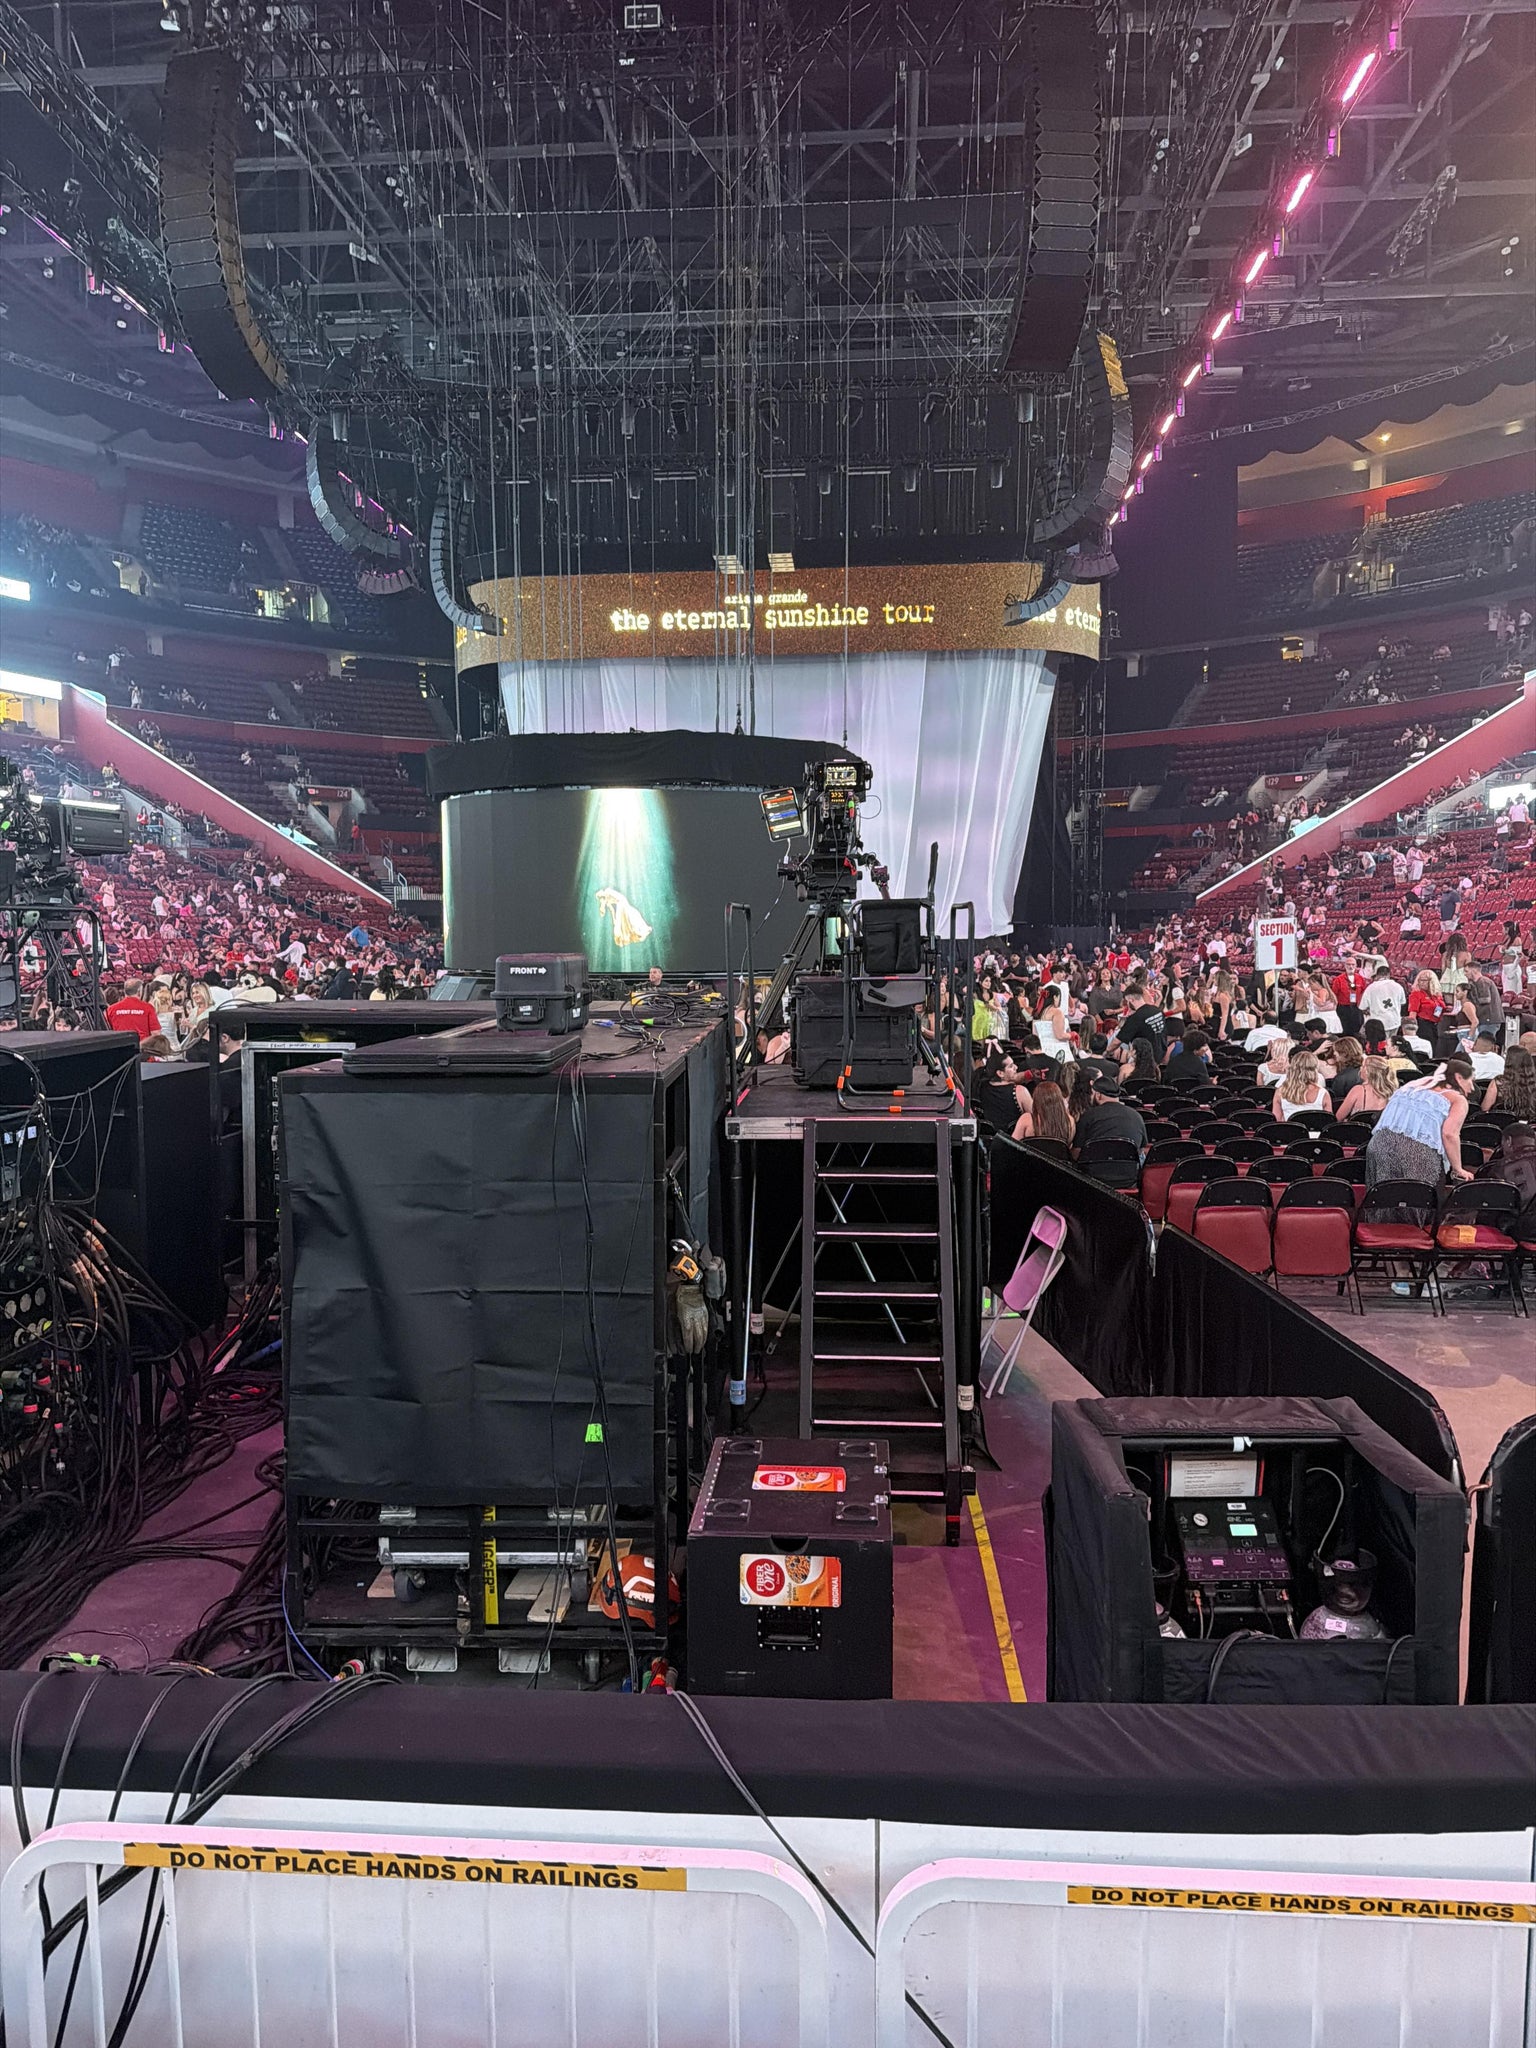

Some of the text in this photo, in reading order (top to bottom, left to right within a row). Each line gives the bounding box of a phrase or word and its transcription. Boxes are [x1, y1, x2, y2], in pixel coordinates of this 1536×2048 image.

[768, 588, 808, 606] grande
[610, 602, 935, 632] the eternal sunshine tour
[1260, 922, 1294, 937] SECTION
[1271, 938, 1283, 965] 1
[756, 1564, 765, 1592] FIBER
[831, 1576, 840, 1608] ORIGINAL
[170, 1851, 639, 1889] DO NOT PLACE HANDS ON RAILINGS
[1091, 1889, 1515, 1919] DO NOT PLACE HANDS ON RAILINGS
